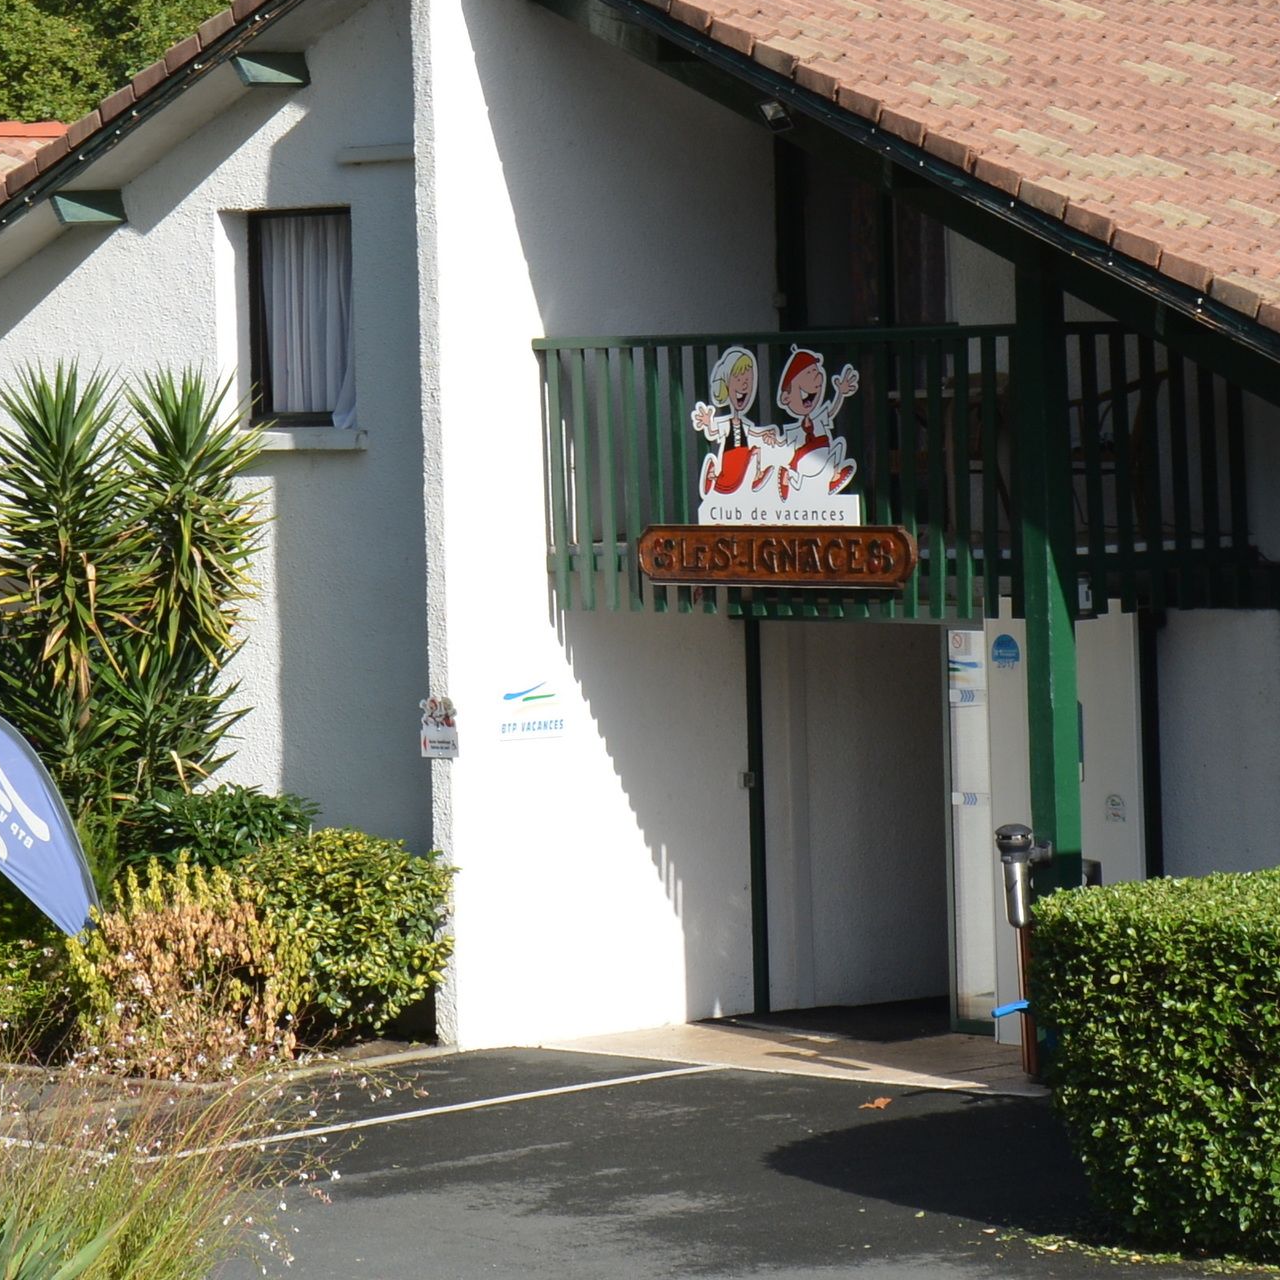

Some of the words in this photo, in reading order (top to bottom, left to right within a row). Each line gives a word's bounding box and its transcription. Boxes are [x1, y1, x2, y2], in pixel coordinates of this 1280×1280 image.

[710, 506, 742, 520] Club
[751, 507, 767, 520] de
[775, 509, 845, 520] vacances
[501, 723, 517, 734] BTP
[521, 719, 564, 732] VACANCES
